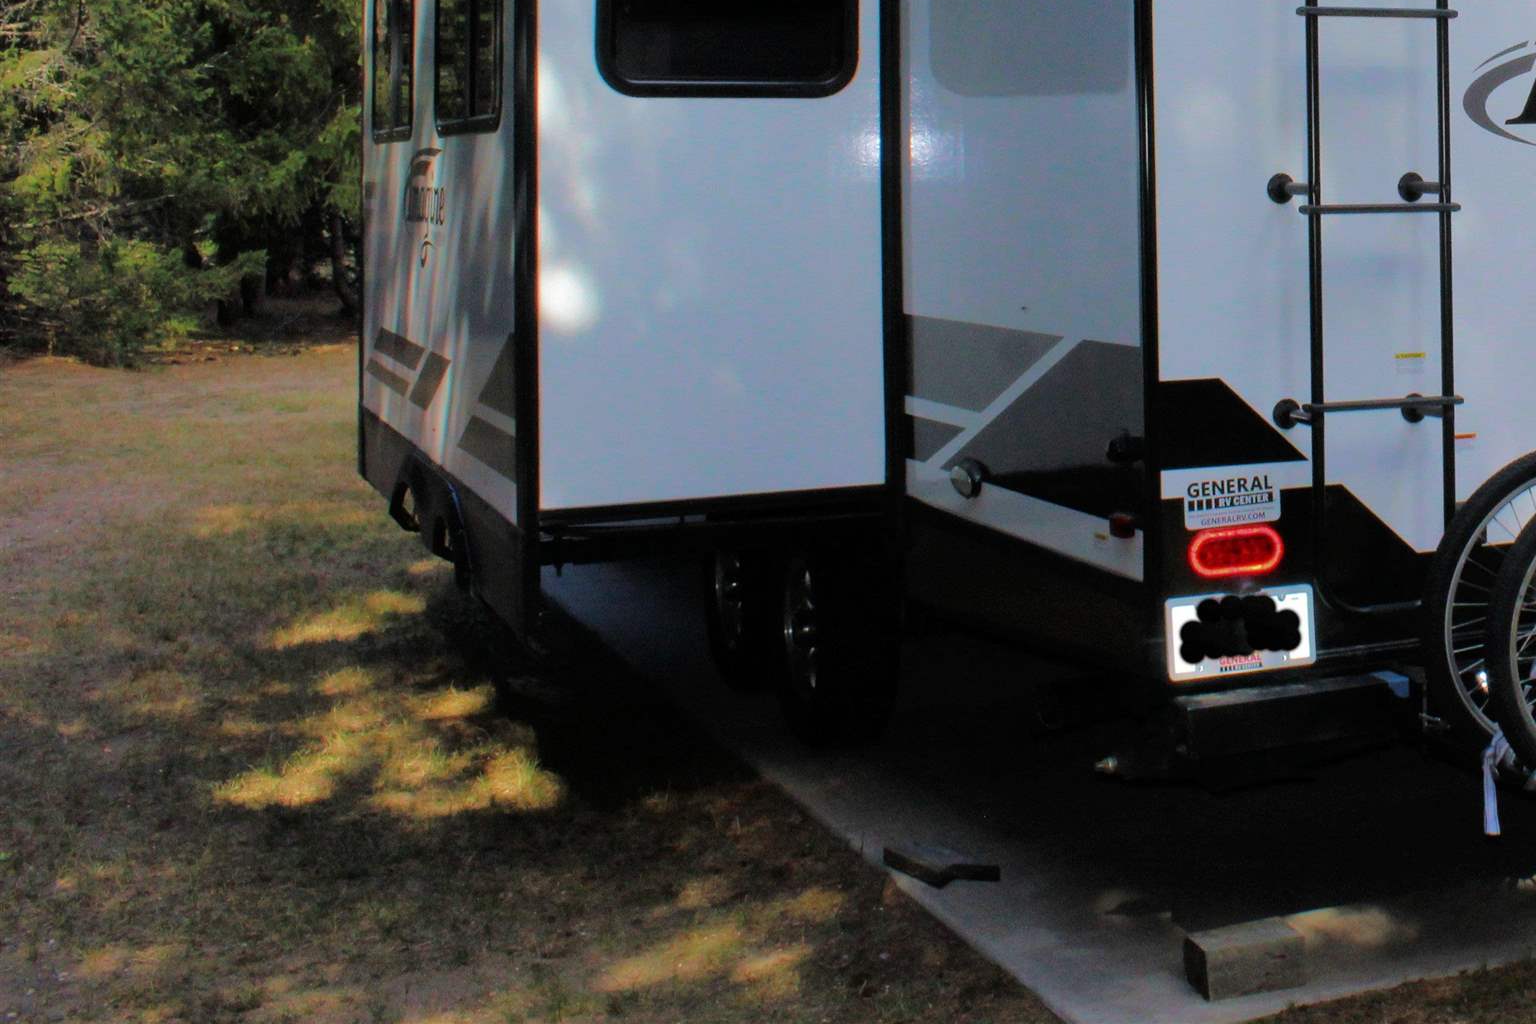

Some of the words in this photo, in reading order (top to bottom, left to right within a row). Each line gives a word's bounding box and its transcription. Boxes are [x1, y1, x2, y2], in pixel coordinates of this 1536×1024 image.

[1187, 475, 1273, 498] GENERAL
[1219, 497, 1232, 507] RV
[1233, 492, 1270, 505] CENTER
[1201, 512, 1266, 526] GENERALRV.COM
